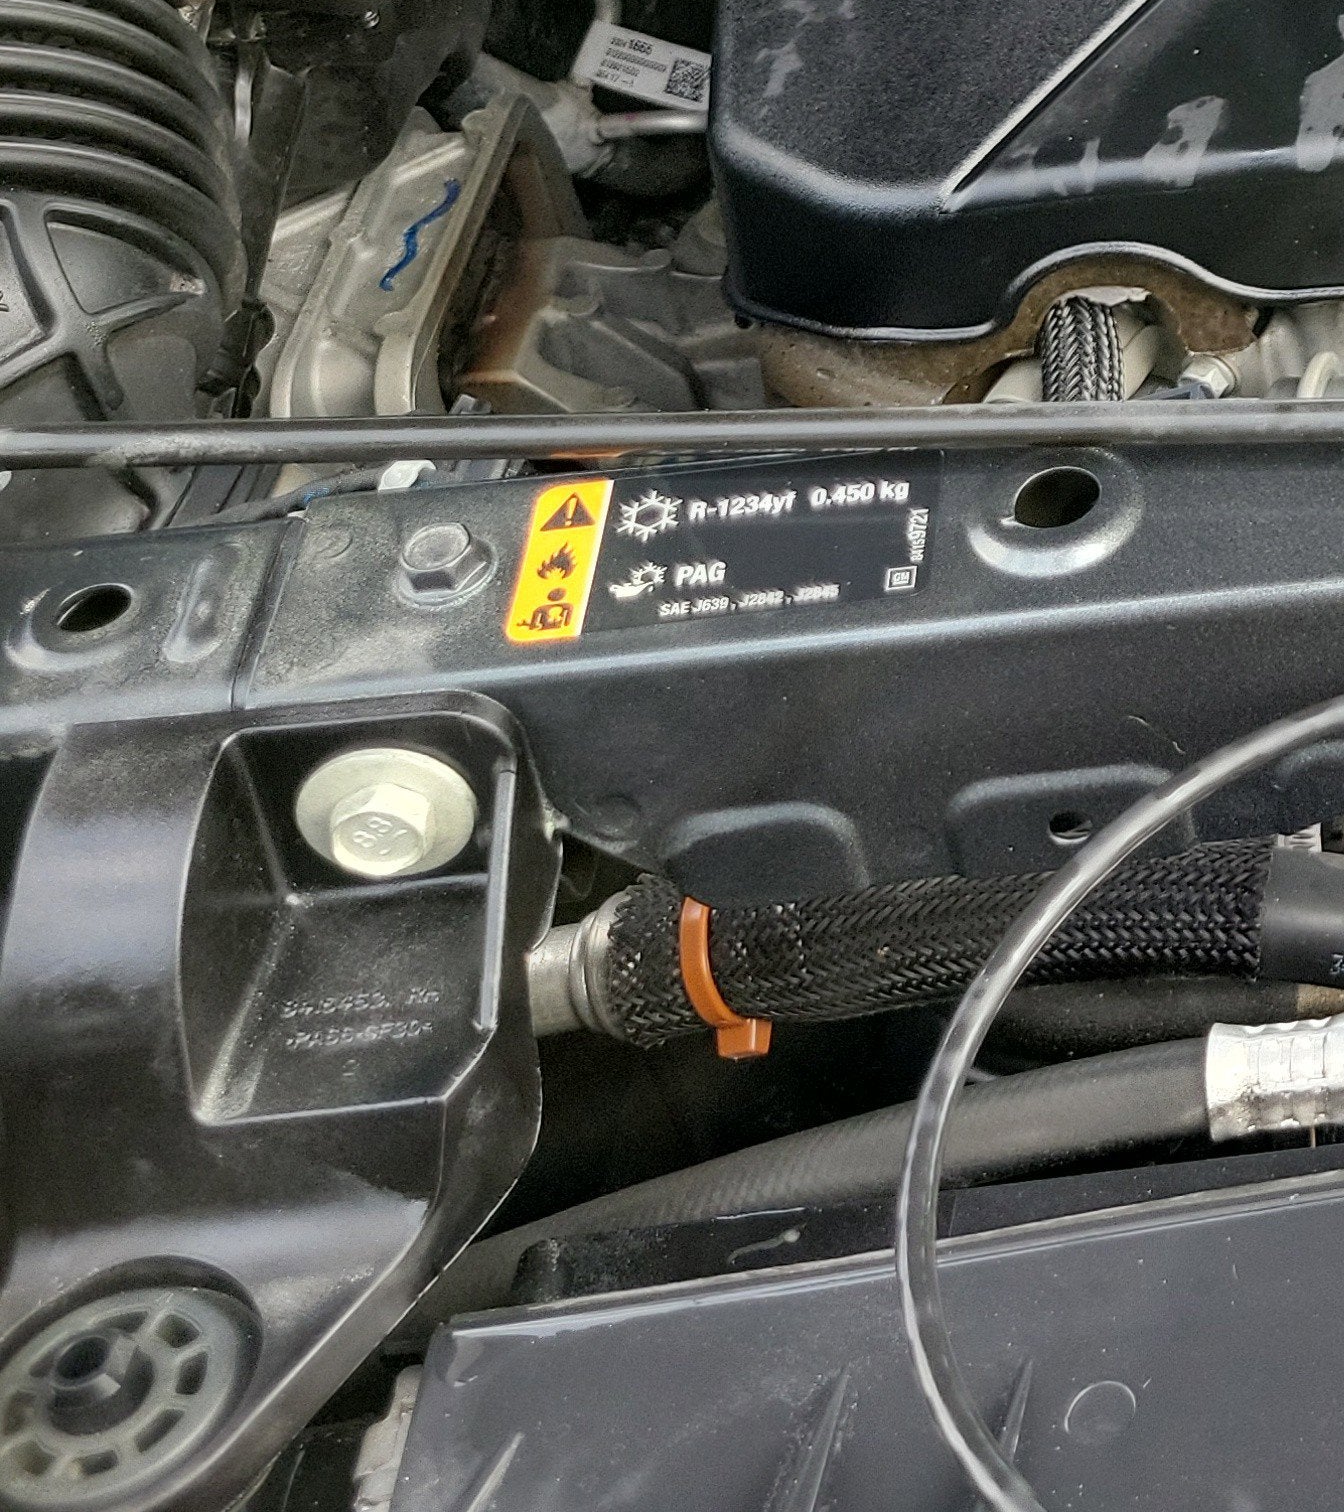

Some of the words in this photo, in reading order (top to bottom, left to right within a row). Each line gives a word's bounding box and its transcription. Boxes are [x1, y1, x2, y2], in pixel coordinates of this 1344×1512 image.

[688, 490, 796, 520] R-1234yf
[811, 483, 876, 506] 0.450
[879, 481, 910, 501] kg
[676, 562, 727, 586] PAG
[659, 600, 690, 617] SAE
